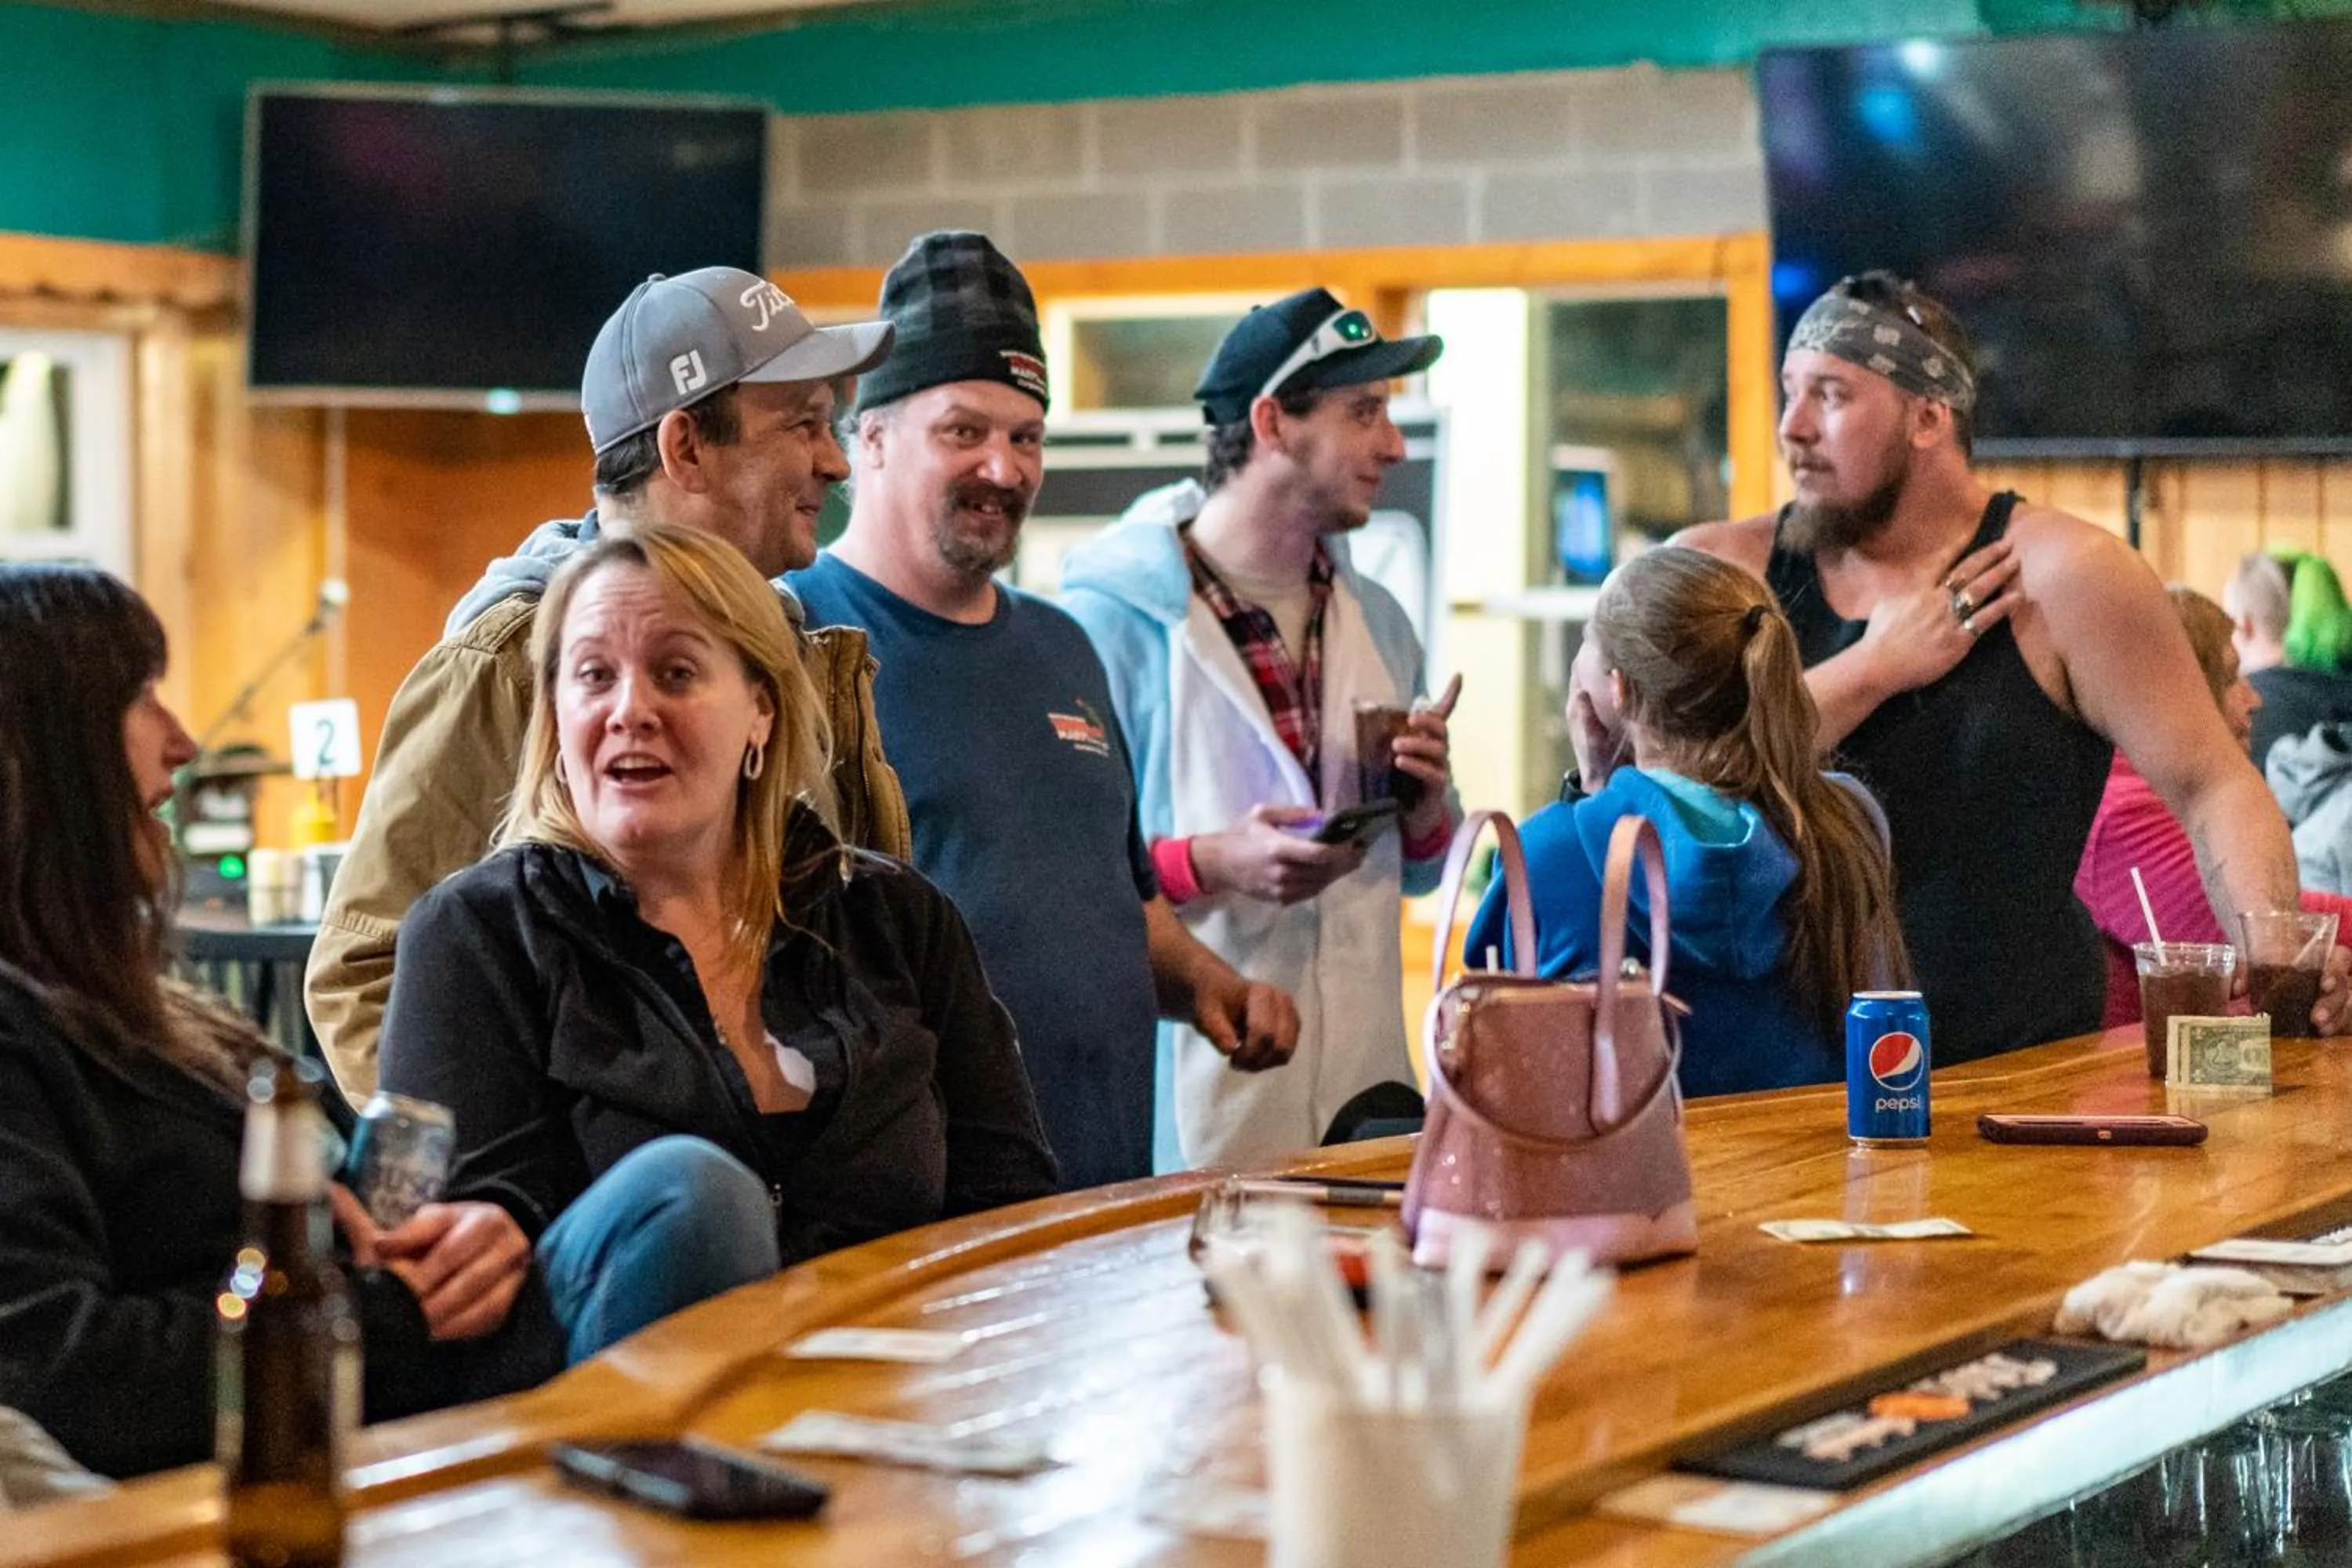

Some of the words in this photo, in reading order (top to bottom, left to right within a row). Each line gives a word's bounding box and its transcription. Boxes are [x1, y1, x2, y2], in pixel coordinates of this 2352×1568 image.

[670, 350, 706, 395] FJ
[315, 719, 336, 765] 2
[1875, 1094, 1920, 1113] pepsi
